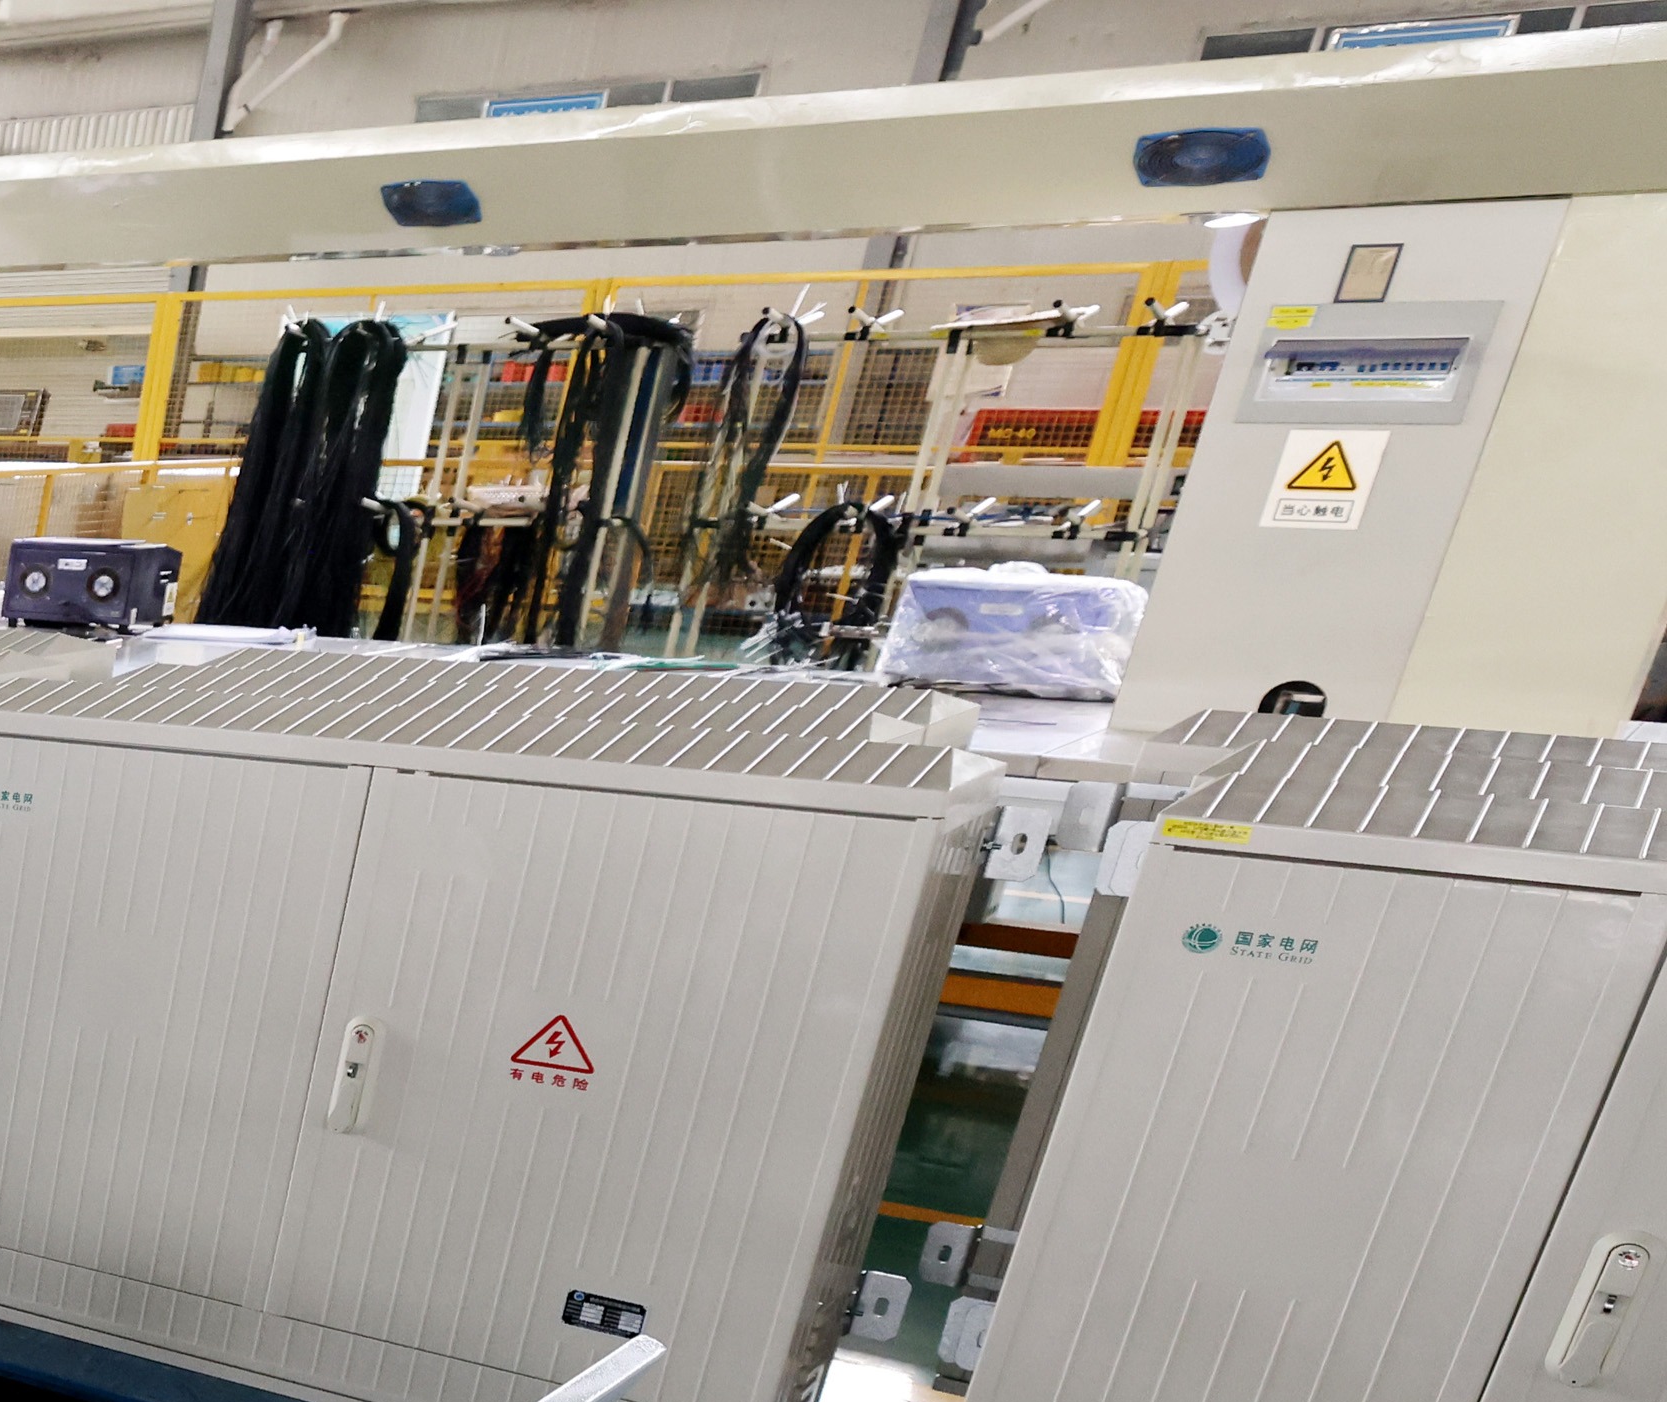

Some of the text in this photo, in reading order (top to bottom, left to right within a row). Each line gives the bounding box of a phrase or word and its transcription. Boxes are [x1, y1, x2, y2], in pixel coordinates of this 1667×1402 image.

[1234, 931, 1319, 955] 国家电网
[510, 1068, 589, 1092] 有电危险
